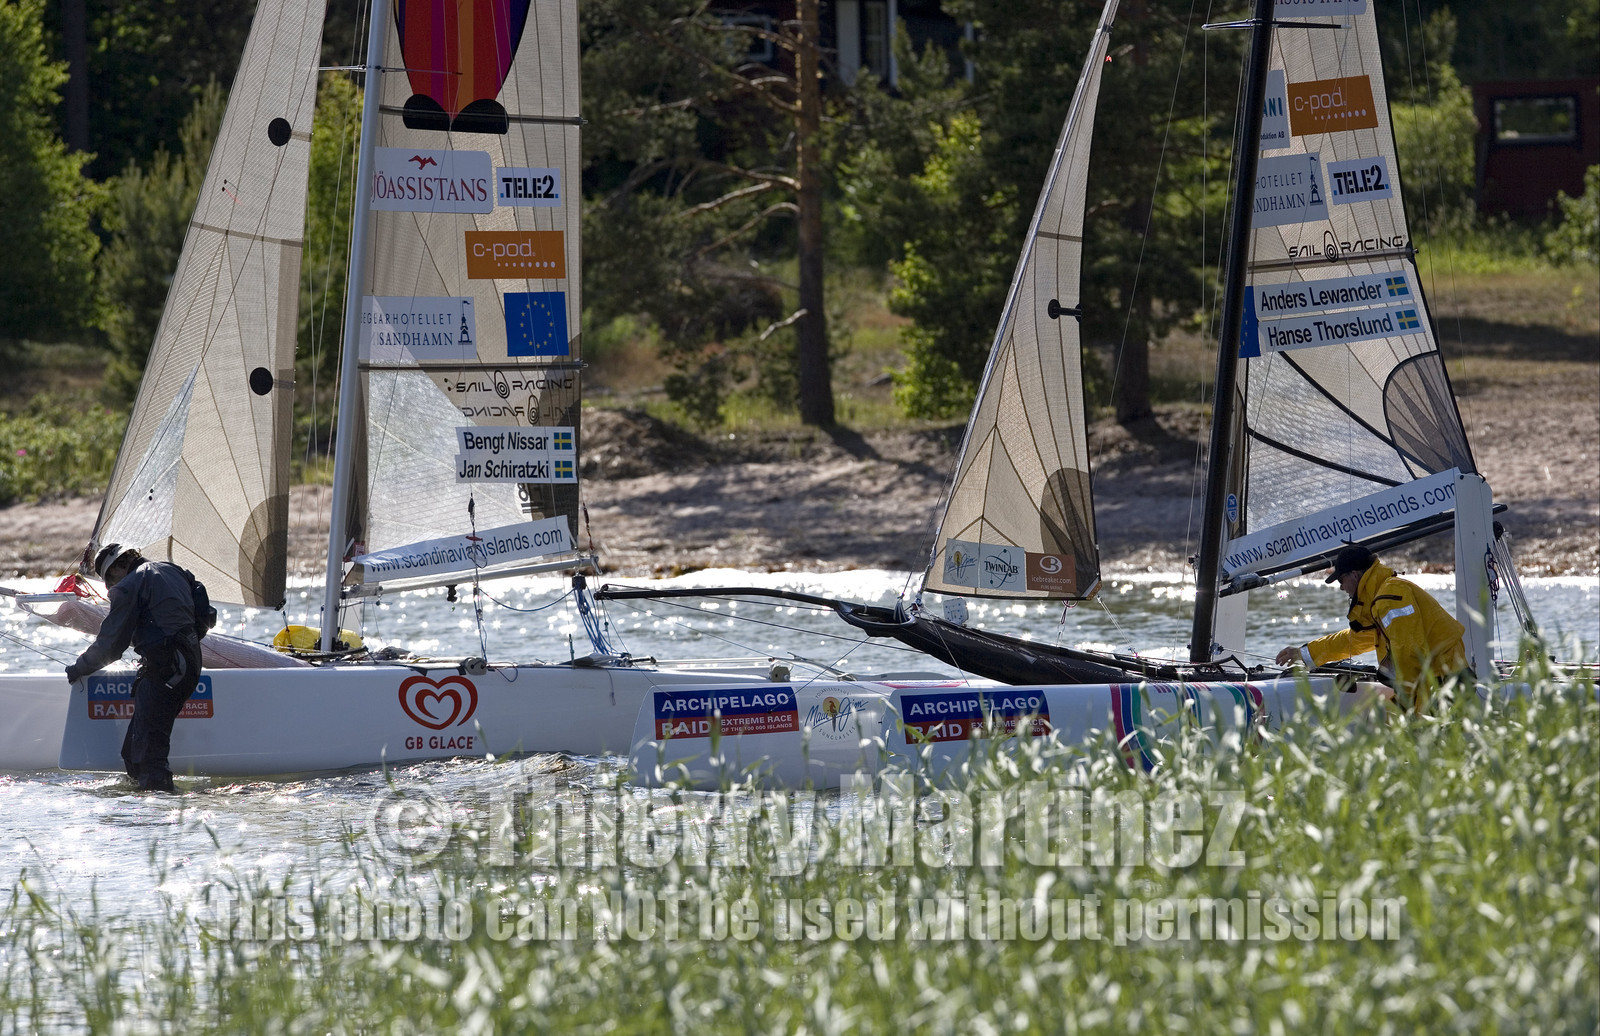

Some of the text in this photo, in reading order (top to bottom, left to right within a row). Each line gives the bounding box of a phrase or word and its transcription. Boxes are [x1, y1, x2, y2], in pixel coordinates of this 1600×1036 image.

[372, 170, 488, 203] JÖASSISTANS
[1261, 281, 1382, 311] Anders Lewander
[379, 332, 453, 346] SANDHAMN
[1268, 313, 1394, 347] Hanse Thorslund
[464, 431, 549, 454] Bengt Nissar
[459, 459, 550, 480] Jan Schiratzki
[371, 528, 563, 573] www.scandinavianislands.com
[984, 560, 1019, 574] TWINLAB
[94, 702, 208, 717] RAID RACE
[661, 693, 789, 712] ARCHIPELAGO
[661, 714, 792, 736] RAID EXTREME RACE
[405, 735, 473, 750] GB GLACE
